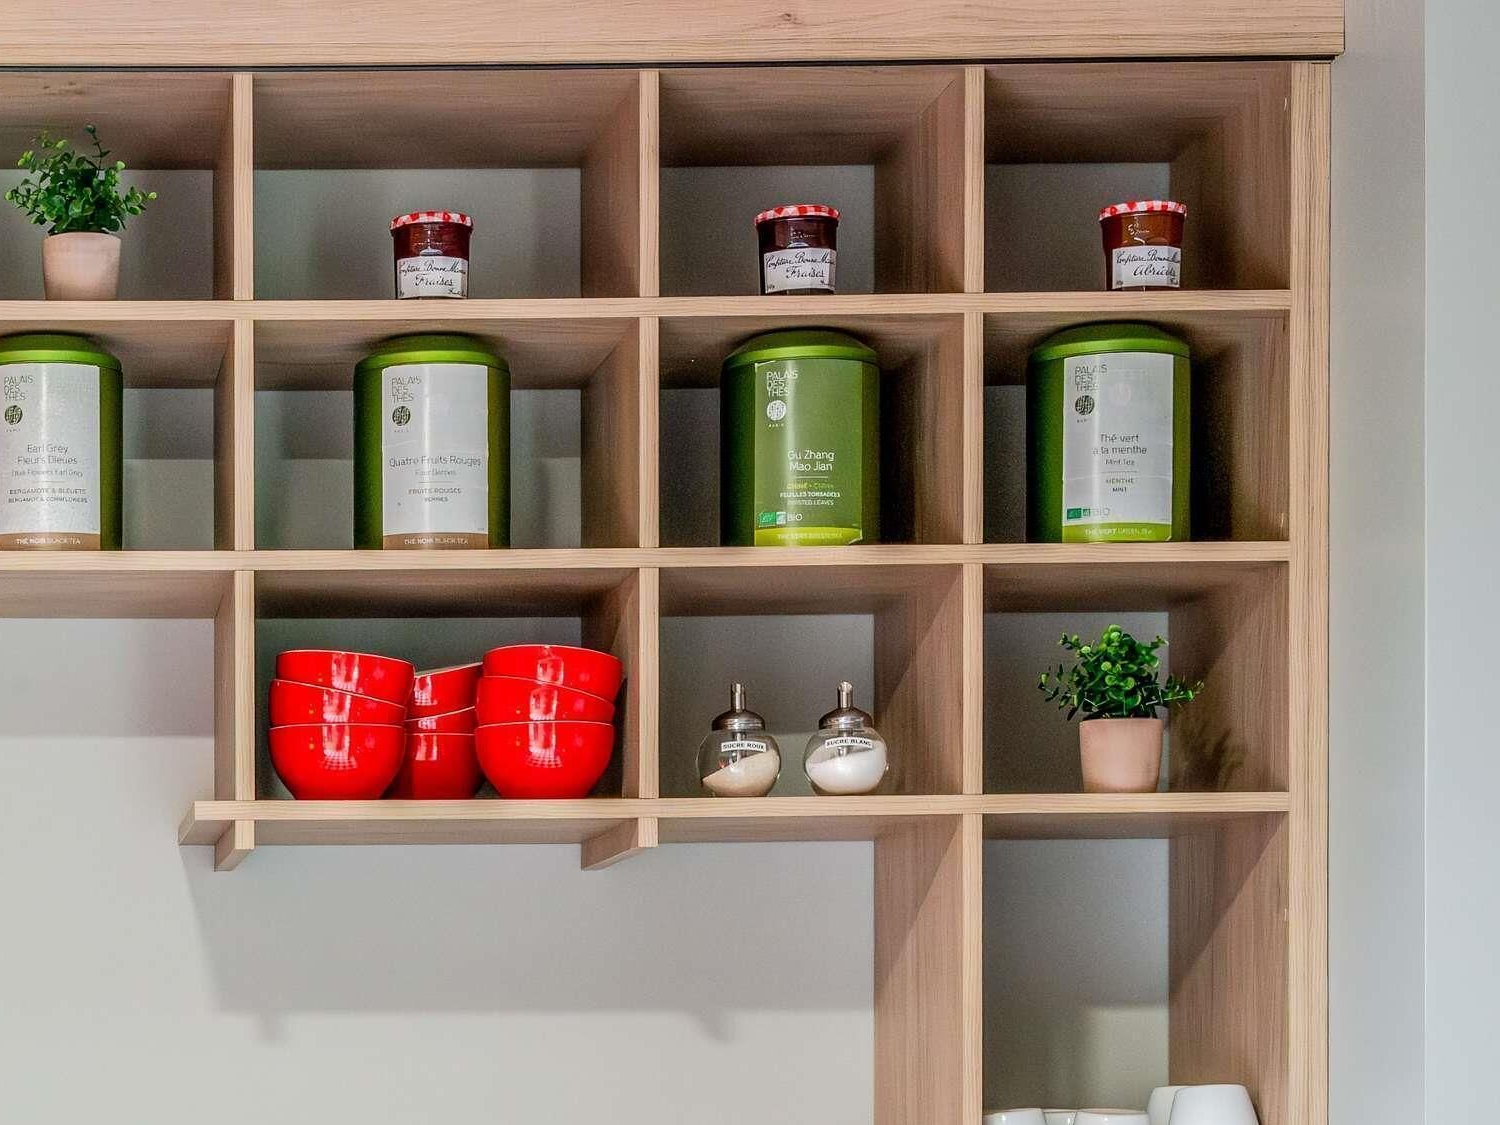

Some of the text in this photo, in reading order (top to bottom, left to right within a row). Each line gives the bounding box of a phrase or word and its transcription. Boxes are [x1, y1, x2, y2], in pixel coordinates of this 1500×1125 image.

[1074, 364, 1108, 375] PALAIS
[3, 374, 34, 385] PALAIS
[391, 375, 421, 385] PALAIS
[766, 370, 799, 380] PALAIS
[1074, 374, 1094, 385] DES
[3, 385, 20, 394] DES
[391, 385, 409, 394] DES
[766, 380, 786, 390] DES
[1100, 432, 1141, 443] Thé vert
[27, 443, 69, 456] Earl Grey
[1111, 446, 1148, 455] menthe
[787, 450, 836, 462] Gu Zhang
[389, 456, 483, 468] Quatre Fruits Rouges
[789, 462, 834, 473] Mao Jian
[723, 743, 766, 751] SUCRE ROUX
[826, 738, 873, 747] SUCRE BLANC
